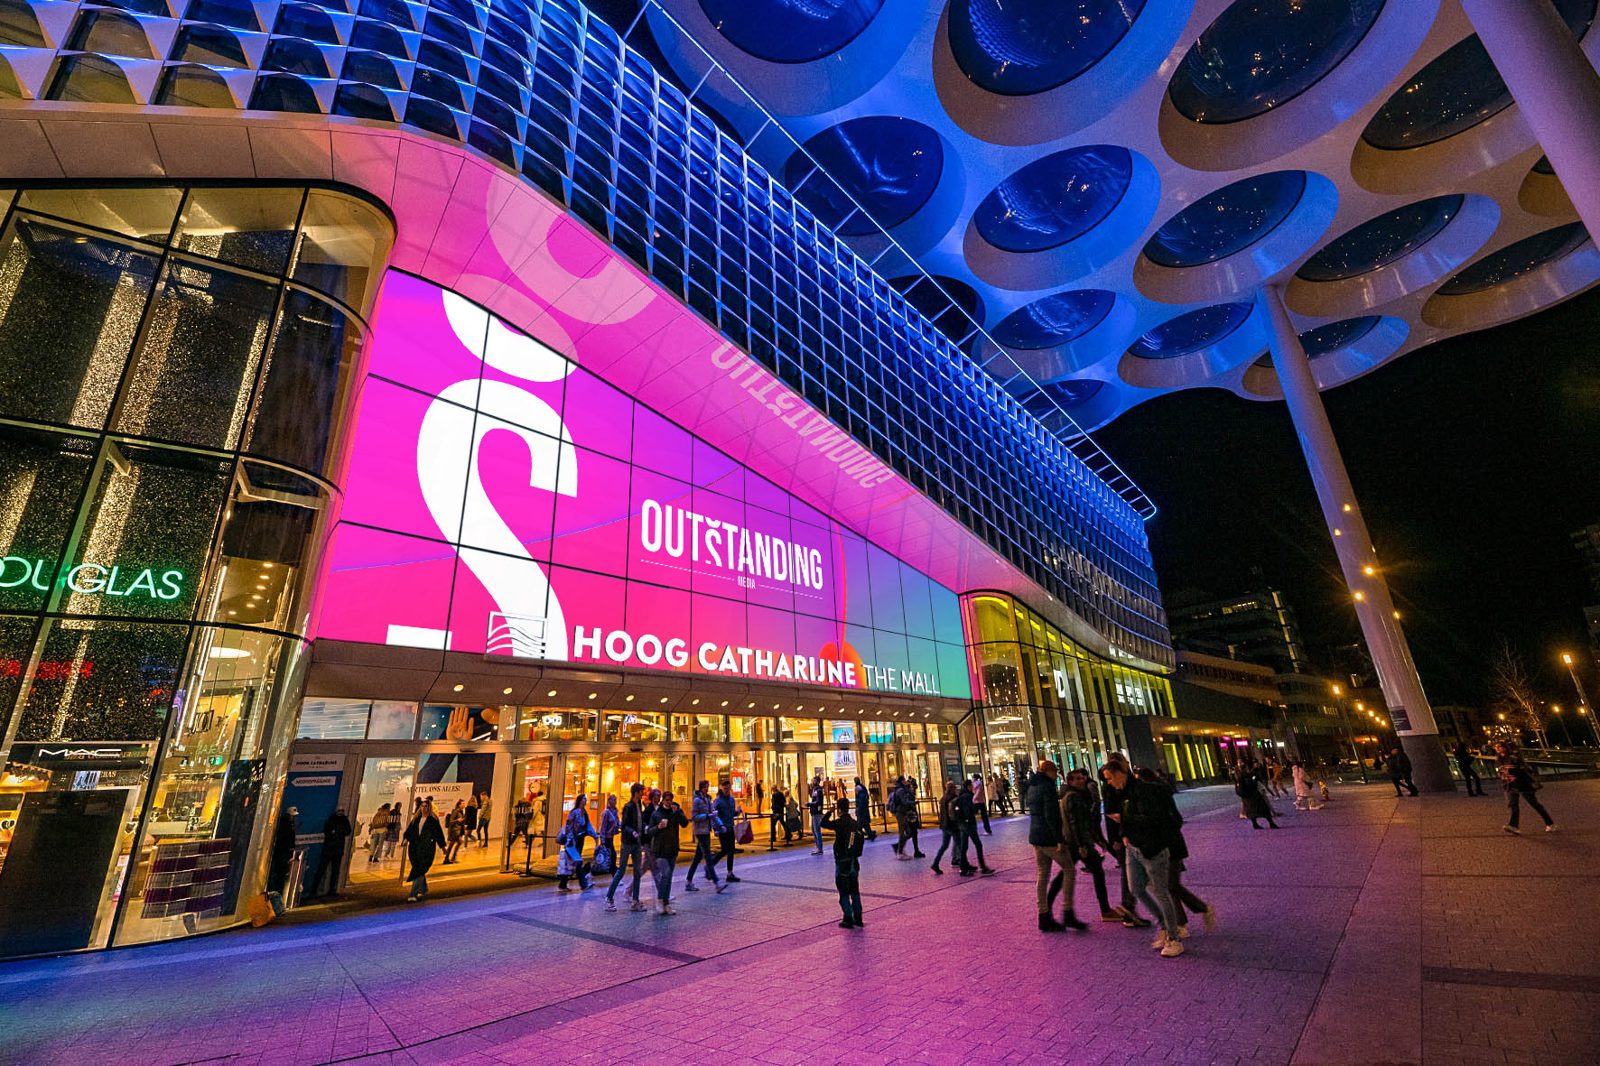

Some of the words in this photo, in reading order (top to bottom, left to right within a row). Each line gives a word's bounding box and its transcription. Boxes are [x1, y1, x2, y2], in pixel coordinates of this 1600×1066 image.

[0, 556, 184, 600] OUGLAS
[737, 575, 757, 589] MEDIA
[573, 623, 689, 669] HOOG
[698, 642, 857, 686] CATHARIJNE
[862, 663, 897, 691] THE
[900, 670, 941, 695] MALL
